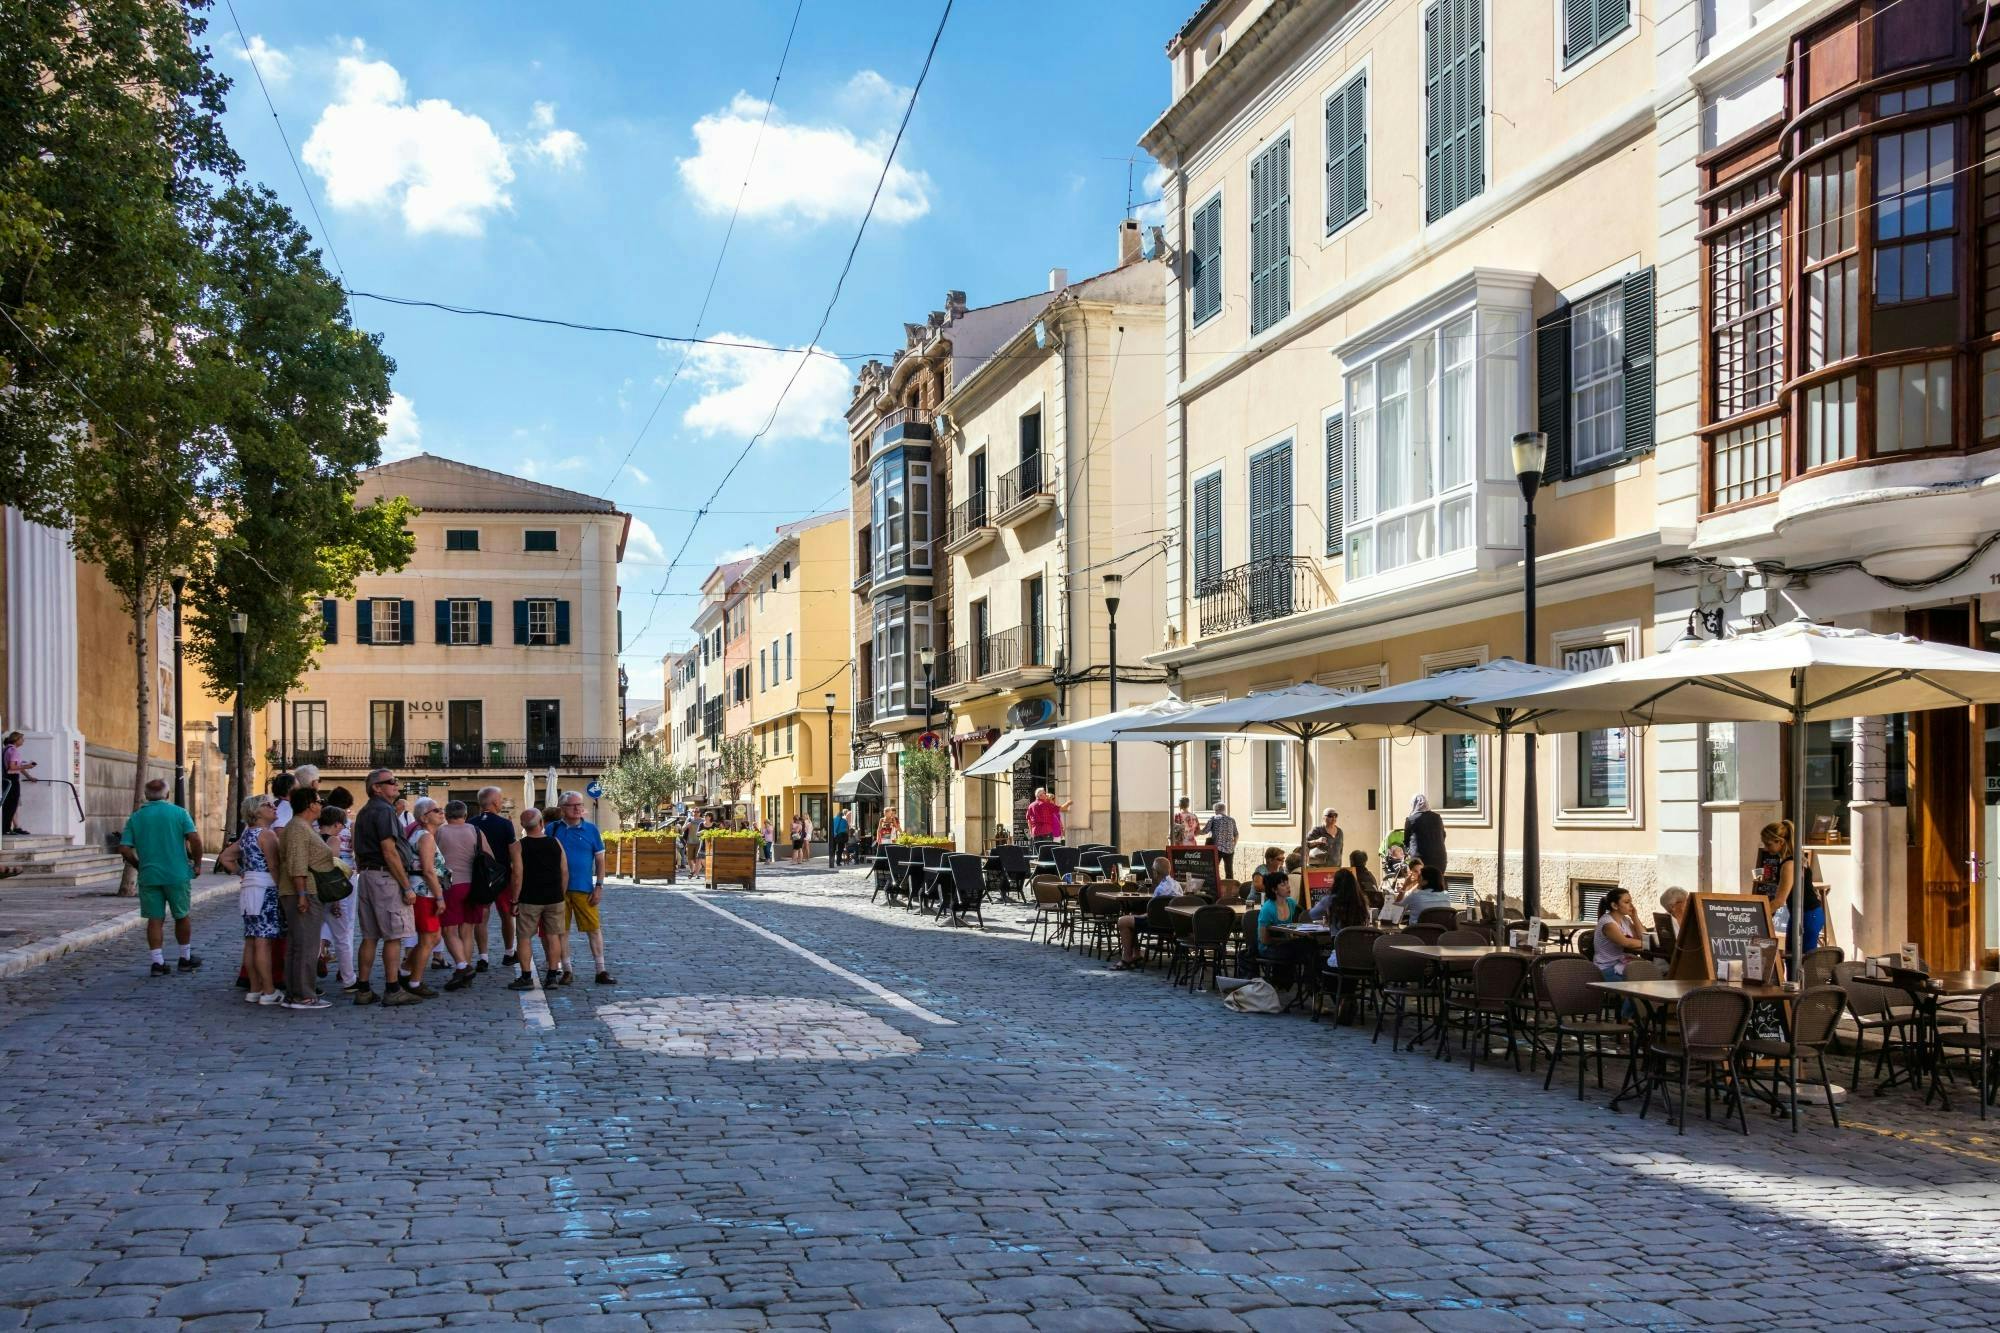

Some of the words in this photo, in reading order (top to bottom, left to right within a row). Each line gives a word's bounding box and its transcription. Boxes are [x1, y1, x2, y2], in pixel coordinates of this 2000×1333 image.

[1564, 645, 1625, 673] BBVA
[408, 700, 444, 712] NOU
[1709, 904, 1733, 912] Disfruta
[1711, 938, 1751, 956] MOJIT
